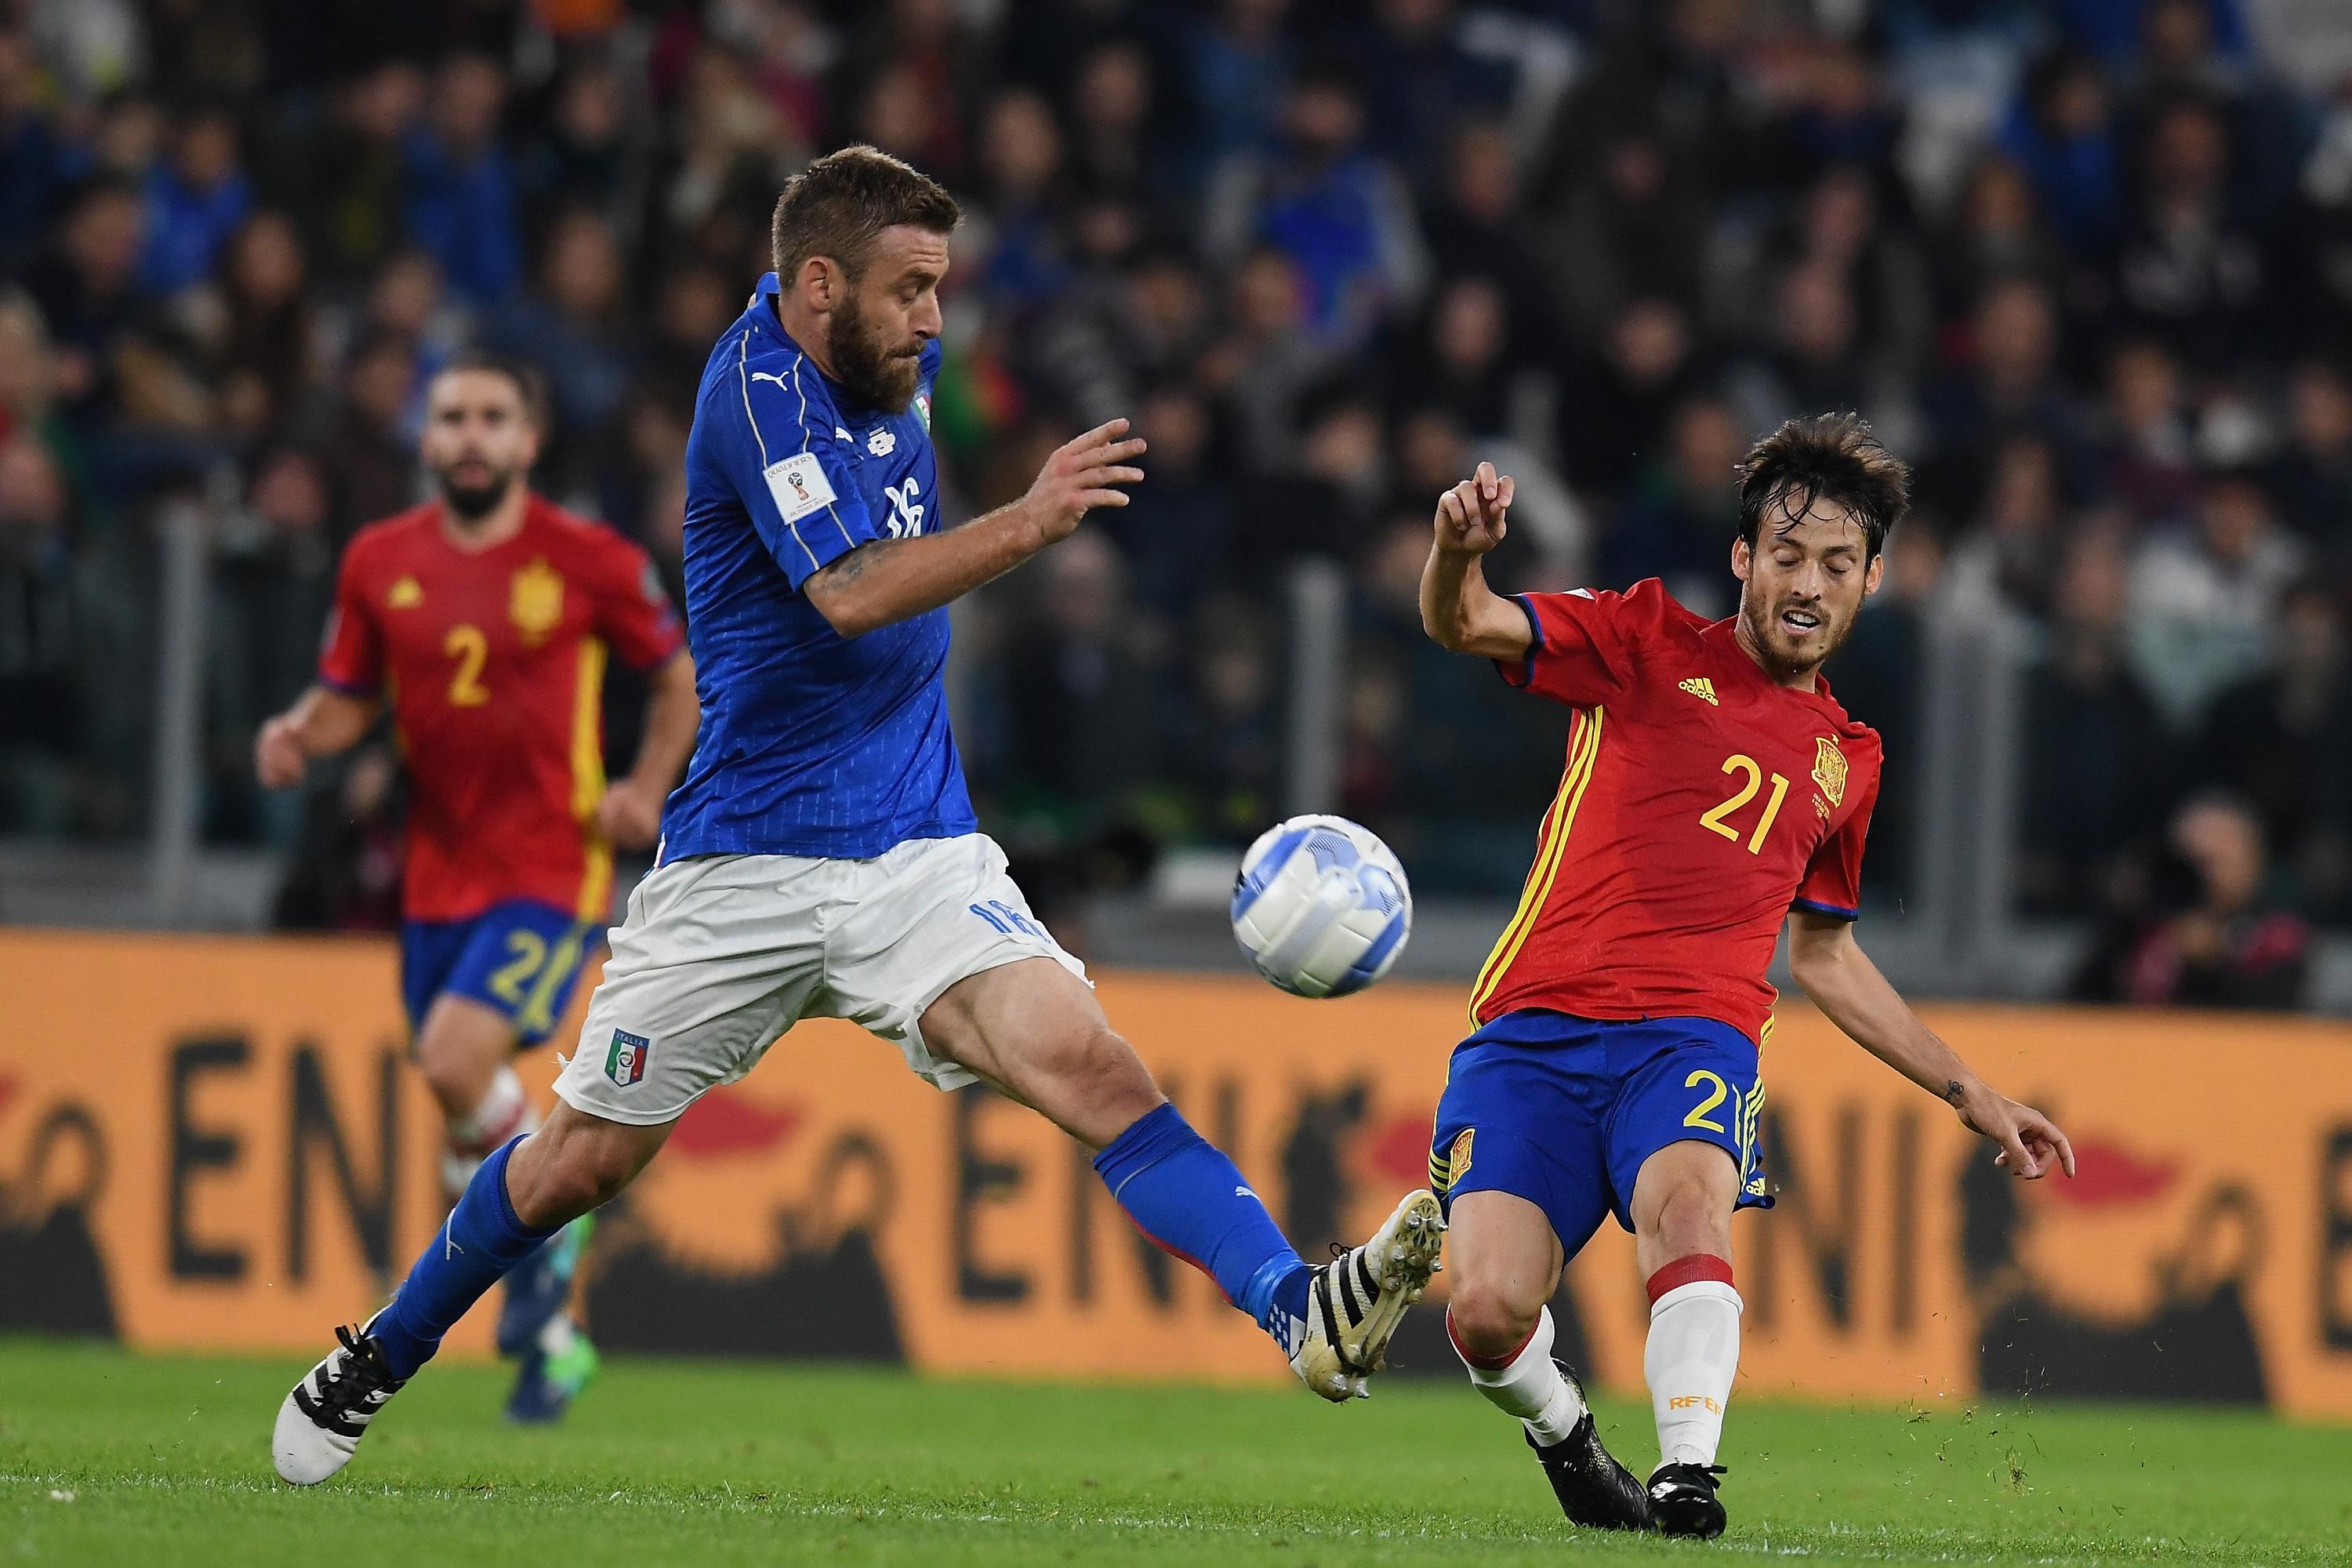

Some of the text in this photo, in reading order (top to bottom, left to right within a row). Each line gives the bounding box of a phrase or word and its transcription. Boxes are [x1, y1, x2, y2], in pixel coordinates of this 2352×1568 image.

[884, 477, 924, 539] 16
[444, 622, 492, 708] 2
[1678, 681, 1719, 706] adidas
[1699, 753, 1790, 856] 21
[615, 1032, 644, 1047] ITALIA
[167, 1035, 401, 1286] EN
[1753, 1100, 1922, 1334] NI
